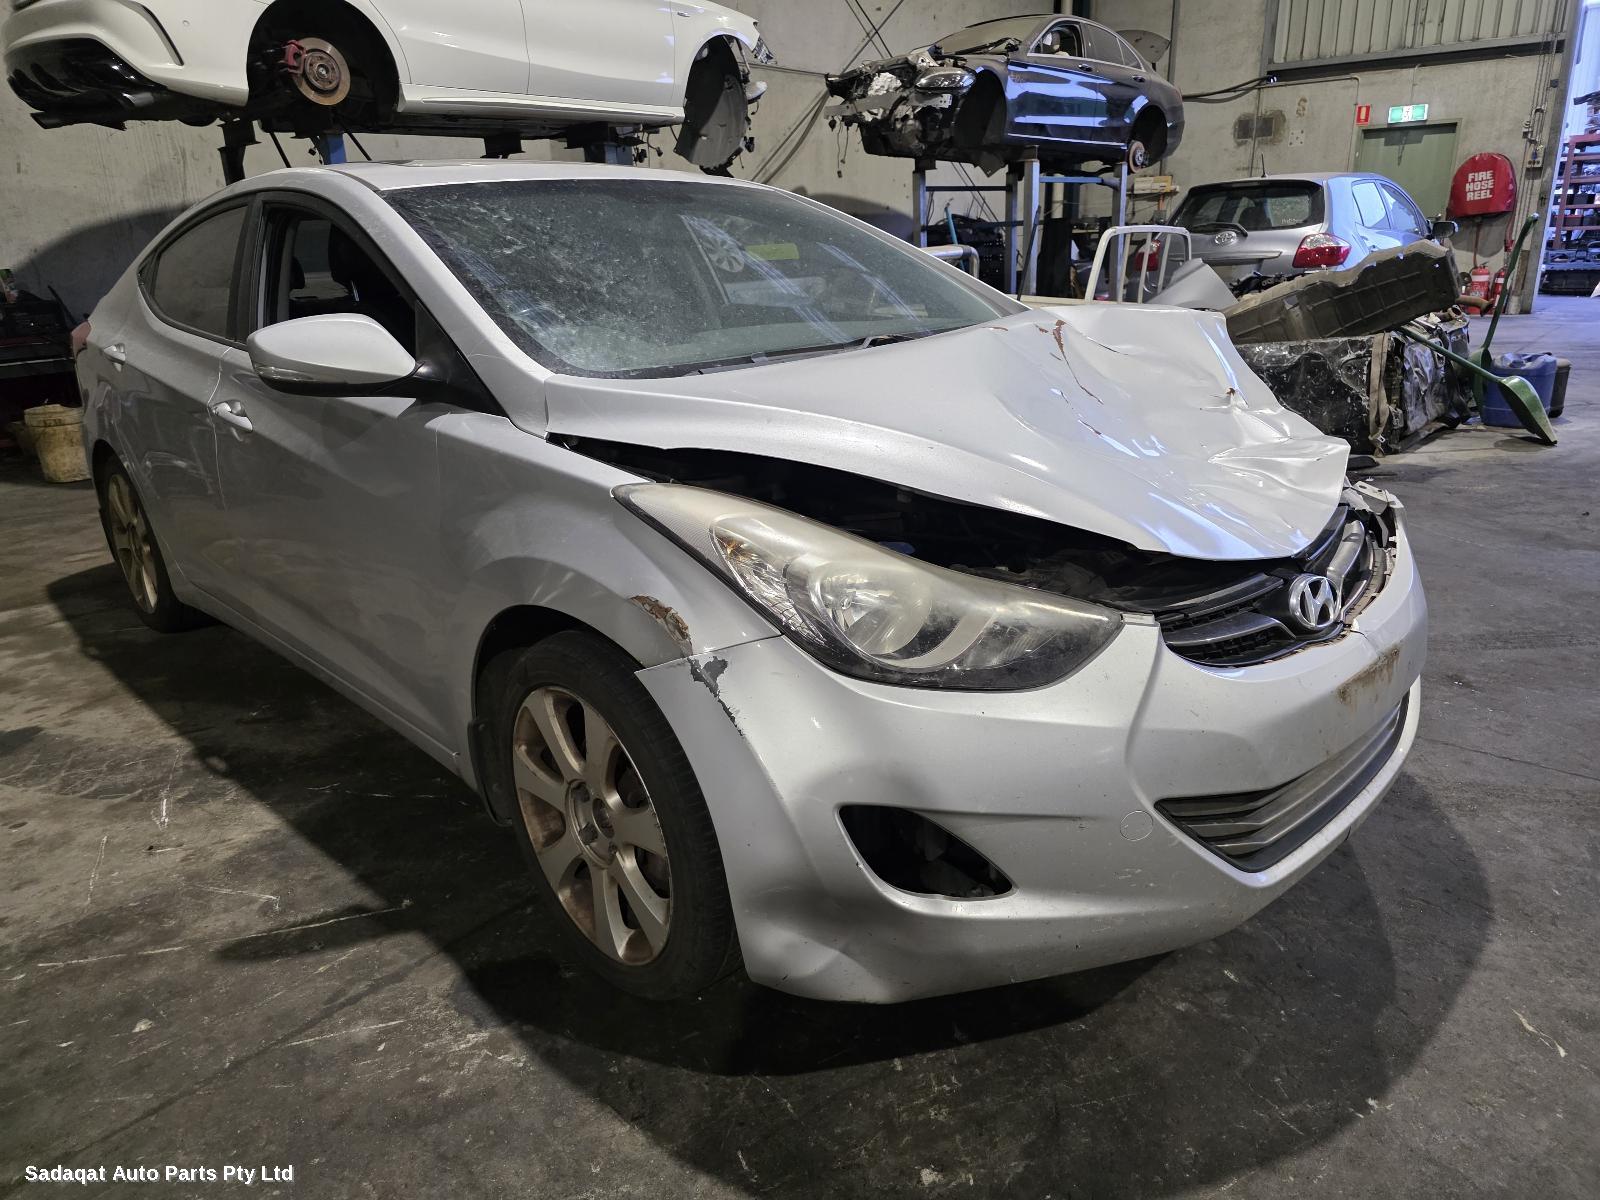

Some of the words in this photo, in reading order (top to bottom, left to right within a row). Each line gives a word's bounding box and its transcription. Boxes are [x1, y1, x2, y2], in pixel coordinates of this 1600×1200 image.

[1468, 170, 1494, 182] FIRE
[1465, 179, 1494, 192] HOSE
[1466, 189, 1493, 202] REEL
